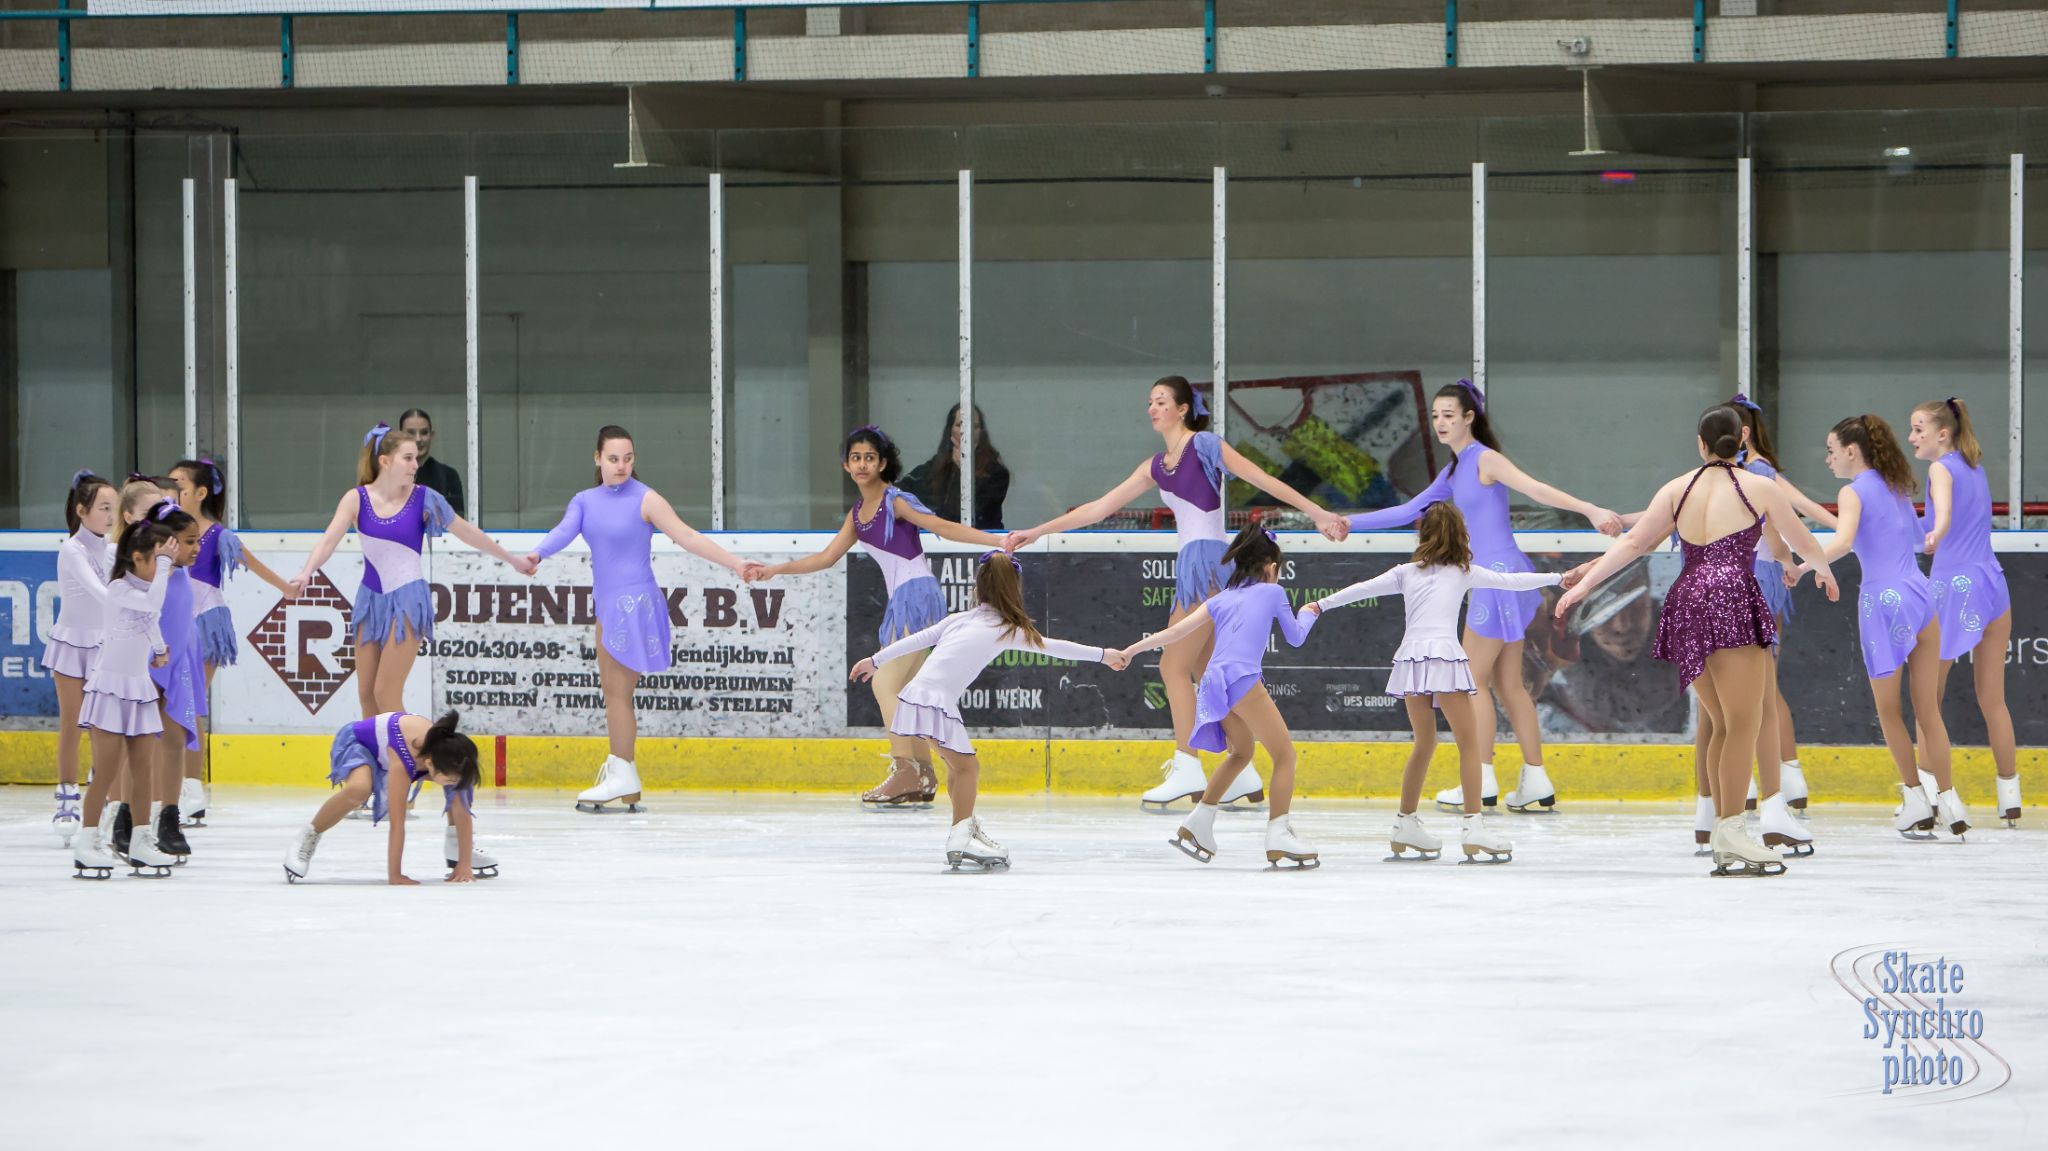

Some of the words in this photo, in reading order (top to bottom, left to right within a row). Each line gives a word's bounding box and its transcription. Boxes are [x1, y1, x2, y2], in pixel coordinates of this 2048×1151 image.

[285, 605, 346, 673] R
[446, 670, 517, 686] SLOPEN
[446, 690, 538, 707] ISOLEREN
[553, 692, 693, 711] TIMMWERK
[708, 697, 793, 713] STELLEN
[960, 688, 990, 710] OOI
[996, 688, 1043, 710] WERK
[1364, 695, 1398, 708] GROUP
